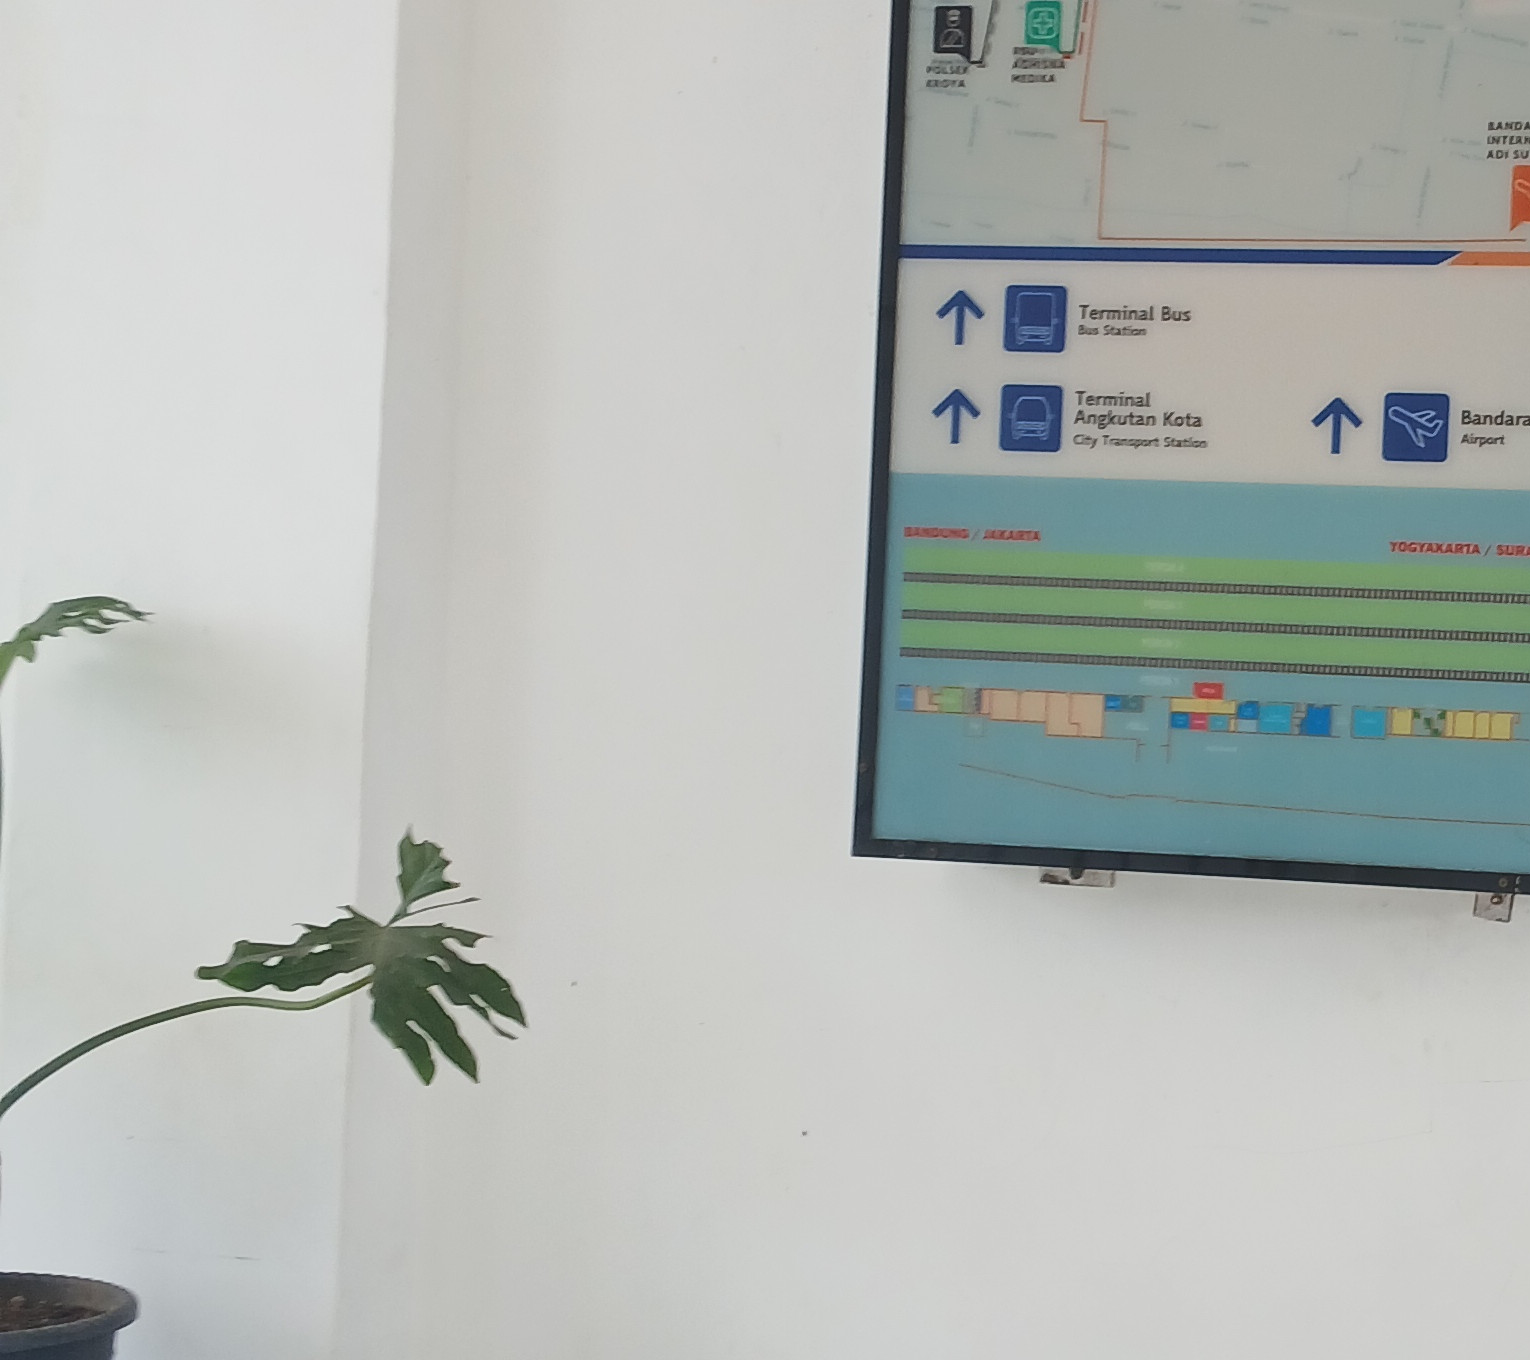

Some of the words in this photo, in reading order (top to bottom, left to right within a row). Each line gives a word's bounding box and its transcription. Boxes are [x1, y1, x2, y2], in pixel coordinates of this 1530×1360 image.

[1486, 150, 1509, 160] ADI
[1079, 305, 1154, 321] Terminal
[1161, 306, 1192, 322] Bus
[1078, 325, 1099, 335] Bus
[1104, 325, 1147, 336] Station
[1075, 391, 1151, 407] Terminal
[1074, 410, 1156, 429] Angkutan
[1163, 412, 1203, 427] Kota
[1073, 434, 1098, 449] City
[1102, 435, 1159, 449] Transport
[1163, 436, 1208, 448] Station
[1461, 434, 1505, 447] Airport
[1390, 542, 1481, 555] YOGYAKARTA
